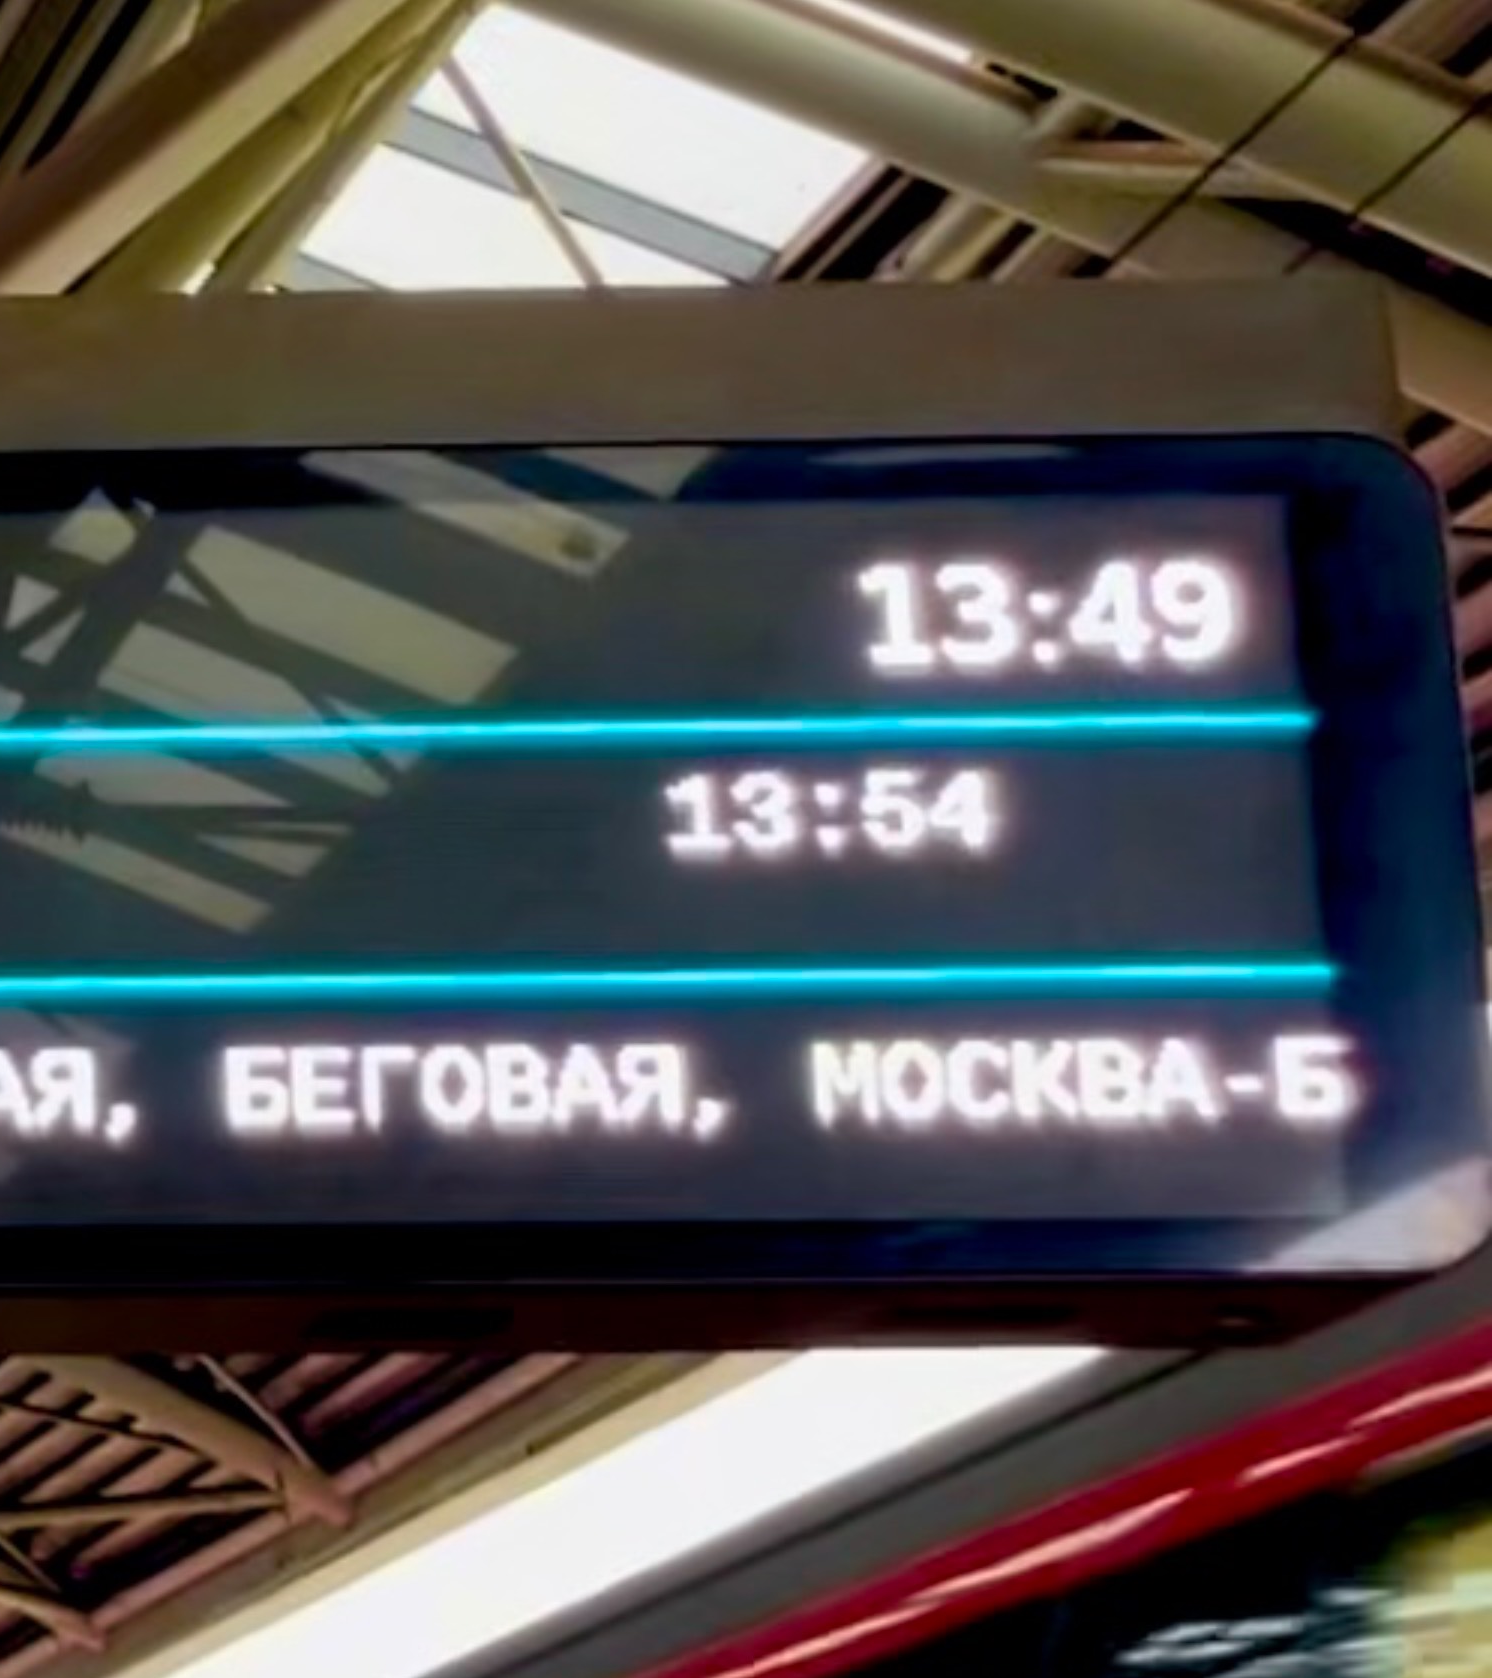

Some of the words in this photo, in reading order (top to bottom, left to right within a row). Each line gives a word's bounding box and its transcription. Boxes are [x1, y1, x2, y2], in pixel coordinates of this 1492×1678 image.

[856, 556, 1242, 676] 13:49
[664, 767, 1000, 857] 13:54
[222, 1041, 727, 1138] БЕГОВАЯ,
[809, 1033, 1356, 1126] МОСКВА-Б
